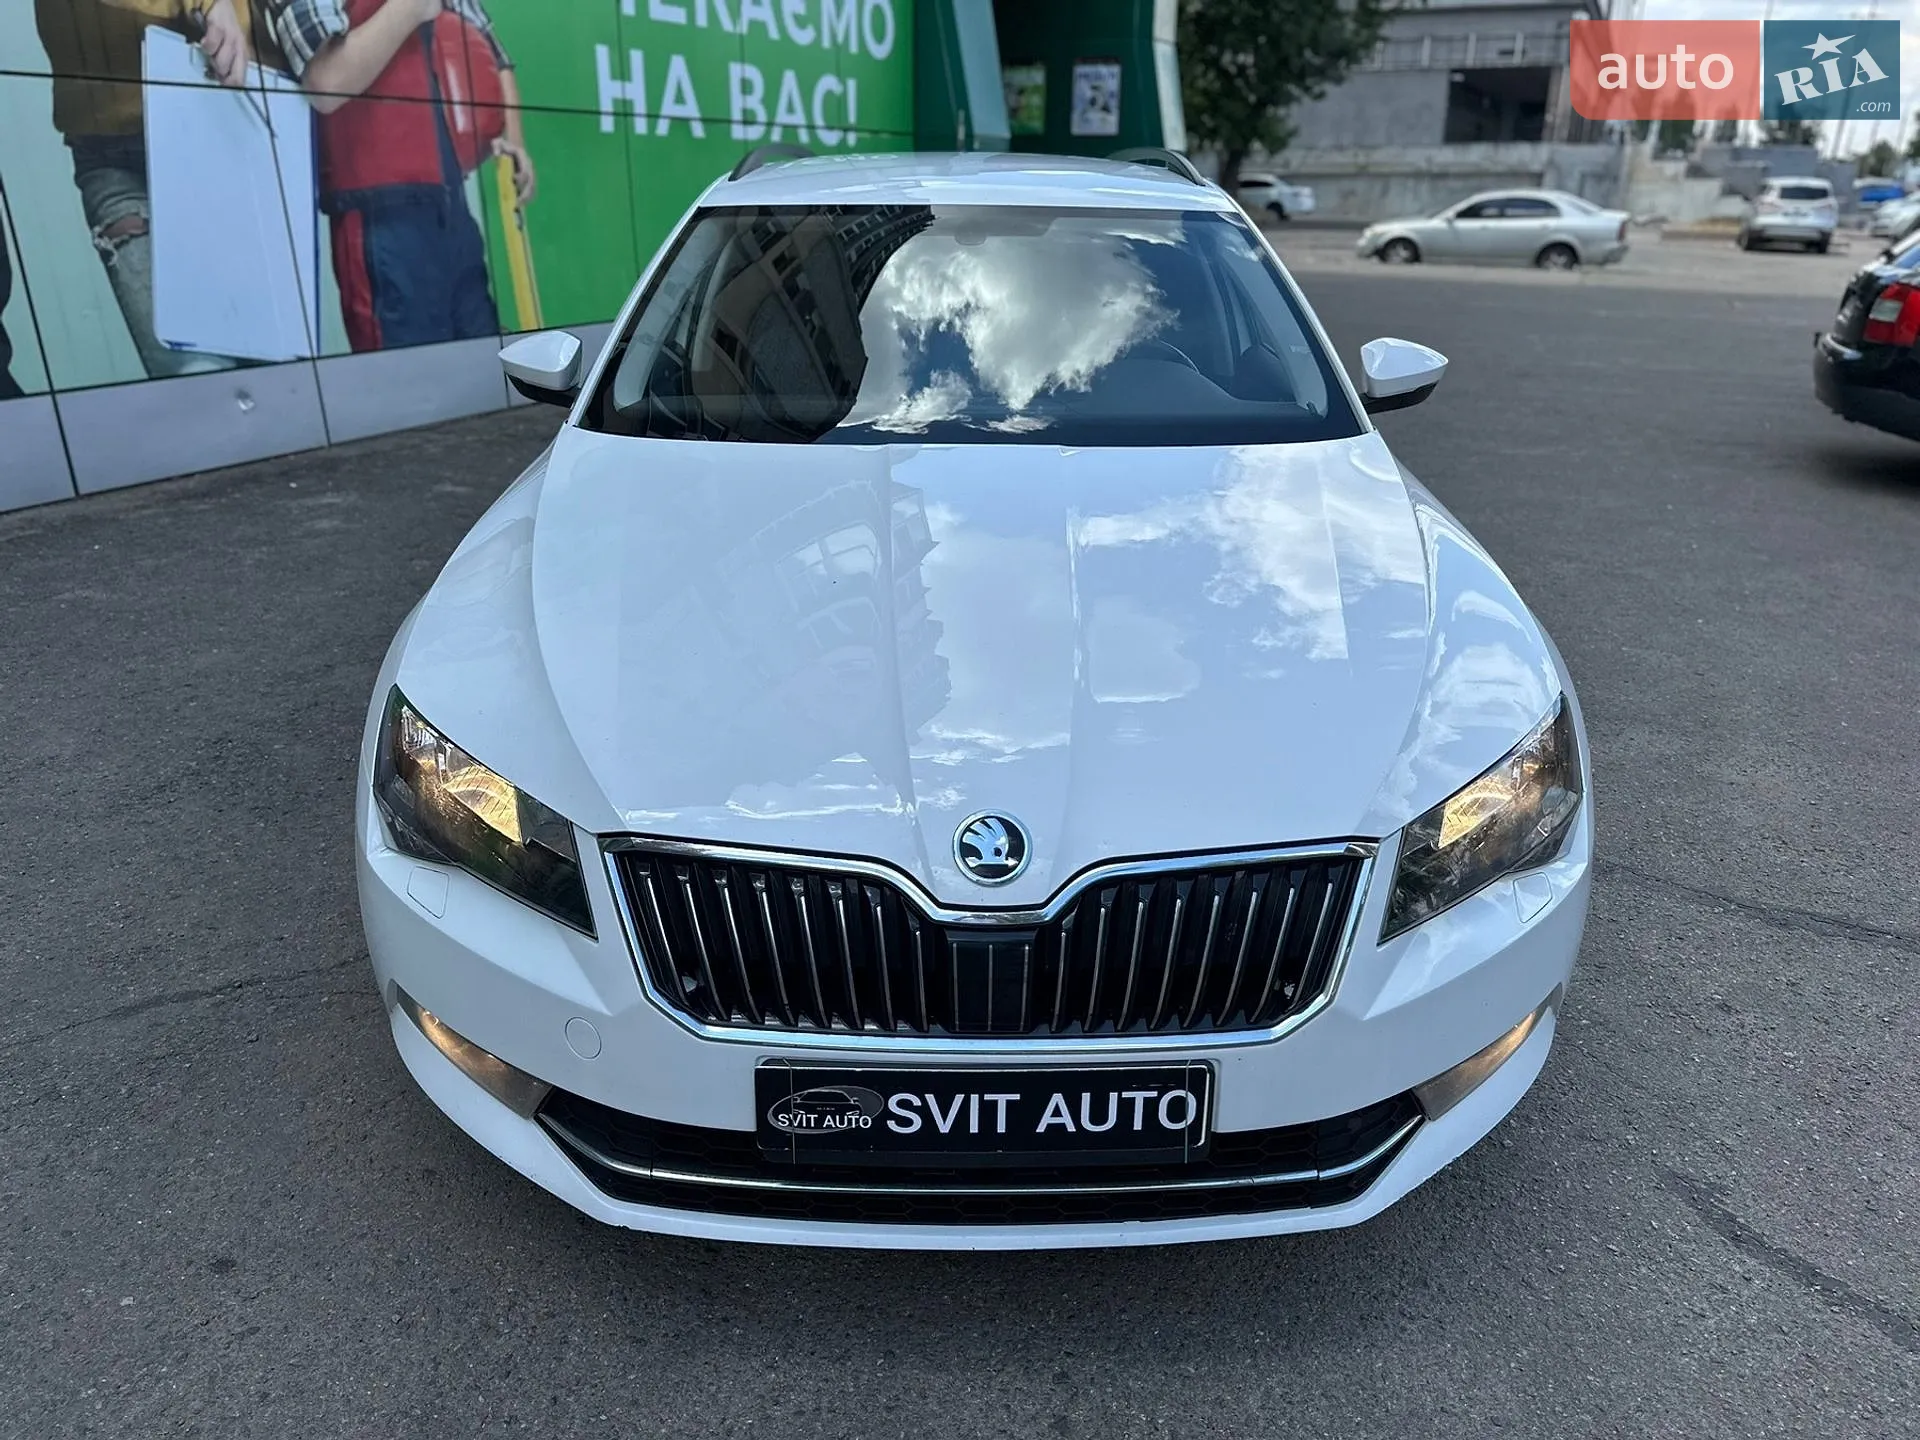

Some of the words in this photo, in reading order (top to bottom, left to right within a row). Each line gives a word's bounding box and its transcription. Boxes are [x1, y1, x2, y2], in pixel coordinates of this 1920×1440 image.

[622, 0, 895, 60] АЄМО
[595, 44, 706, 138] НА
[728, 62, 857, 147] ВАС!
[778, 1113, 818, 1127] SVIT
[823, 1114, 872, 1129] AUTO
[887, 1093, 1020, 1134] SVIT
[1036, 1089, 1197, 1133] AUTO
